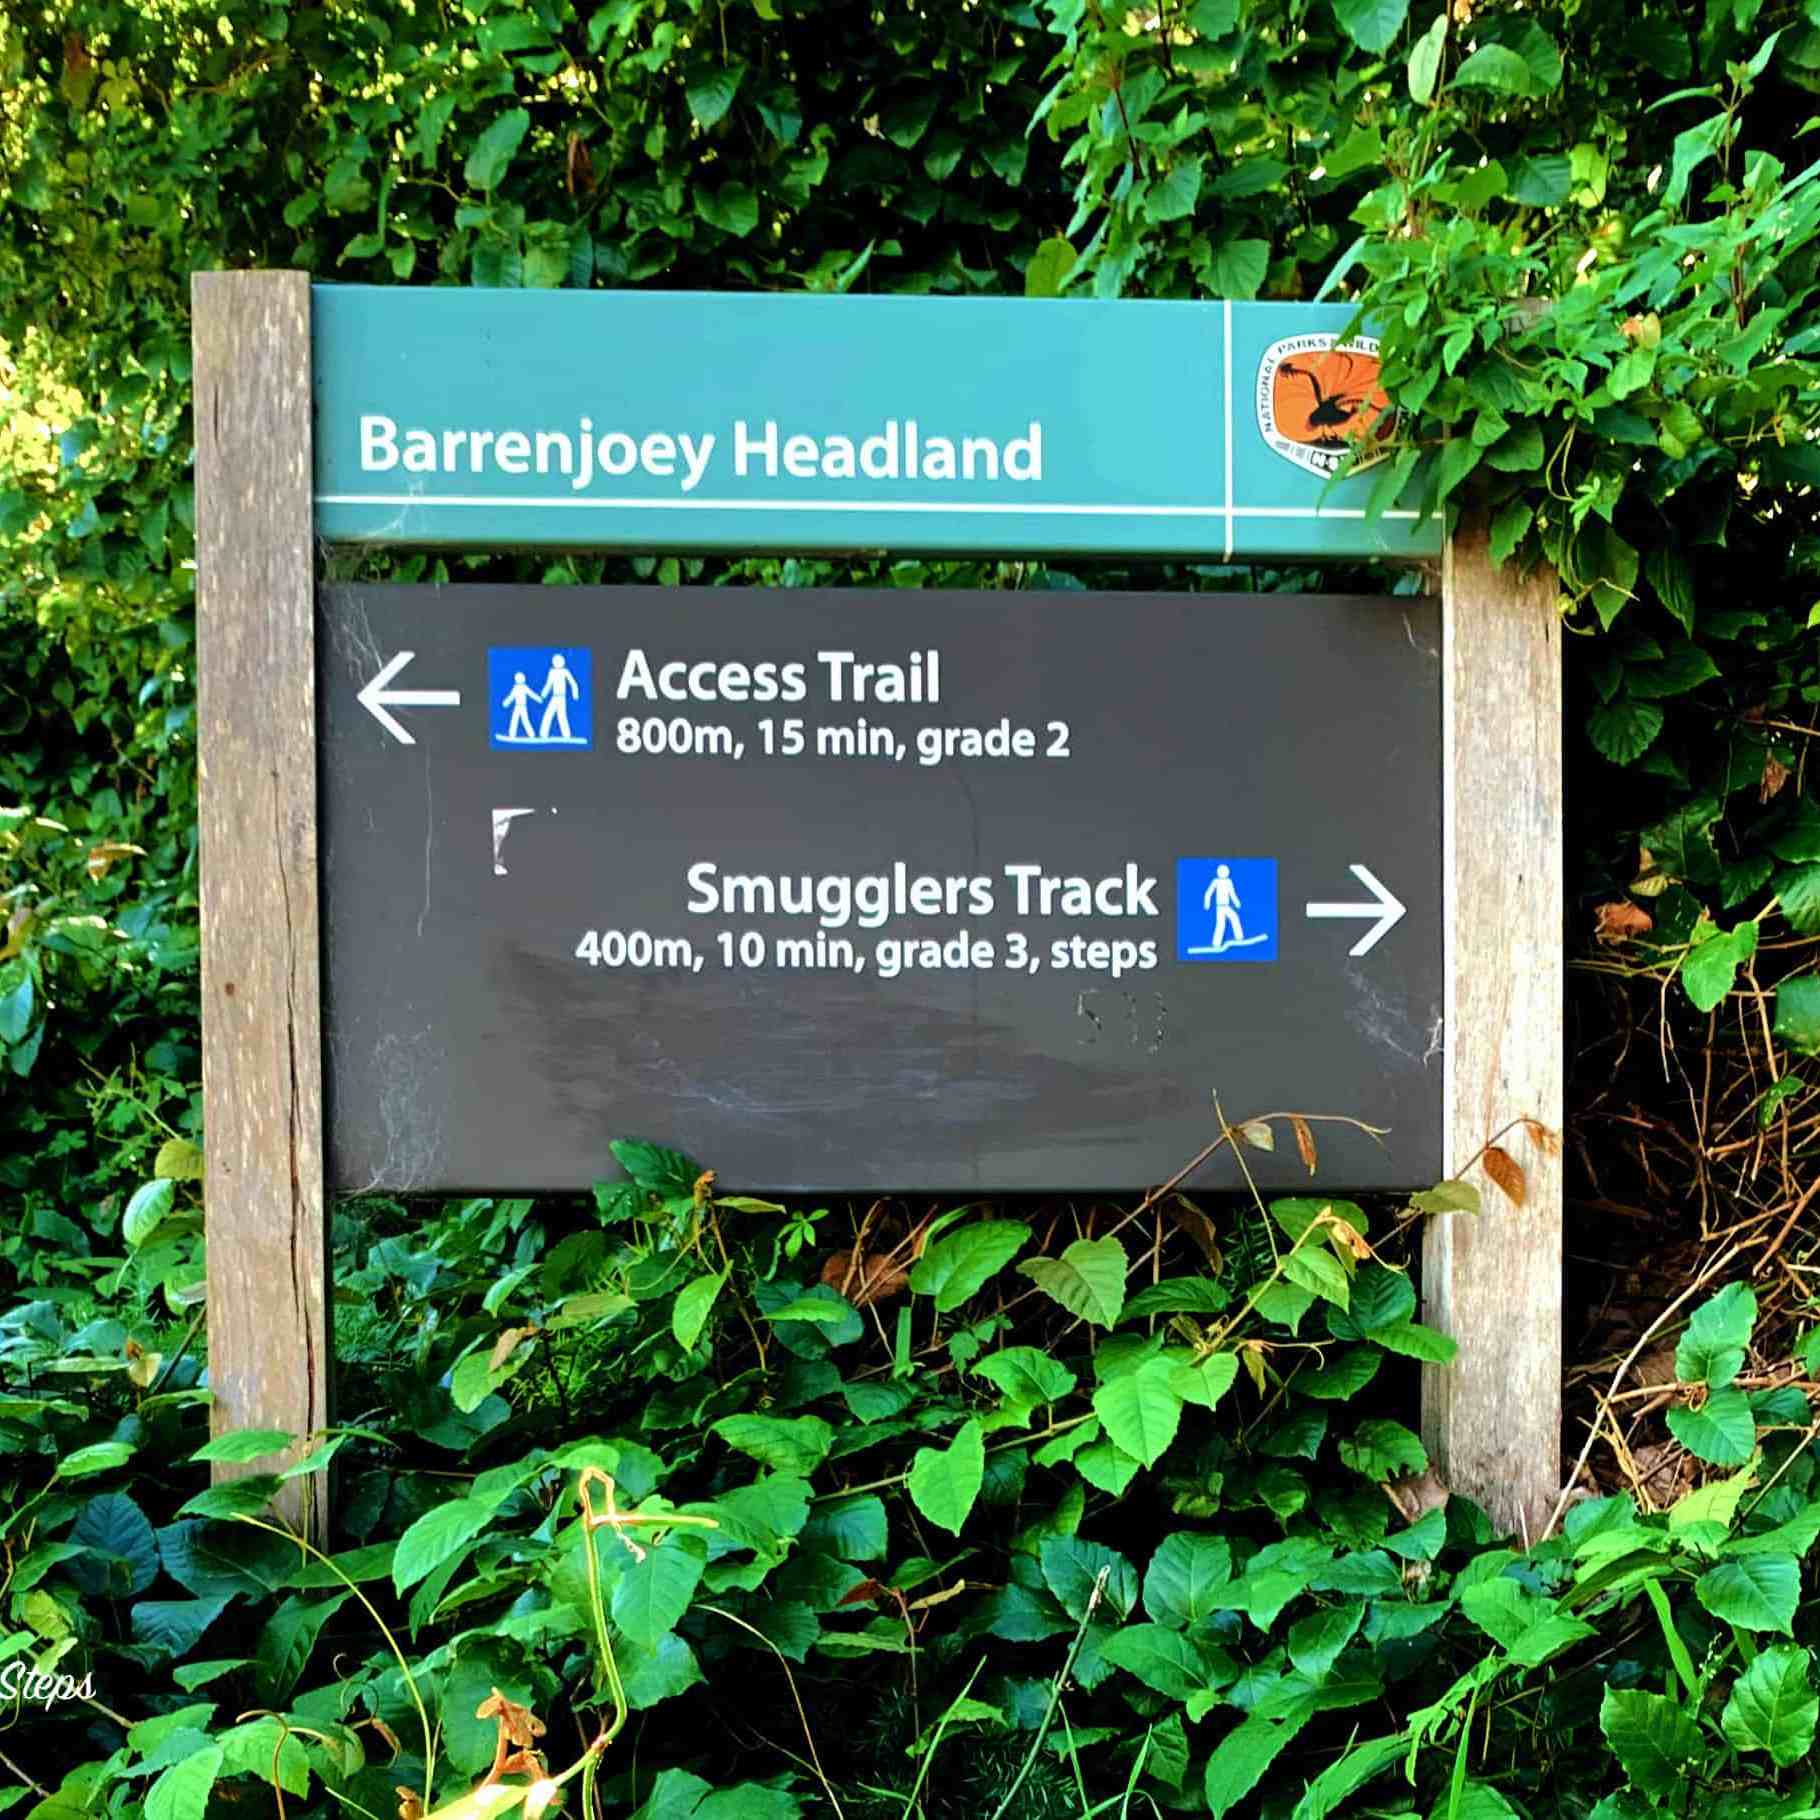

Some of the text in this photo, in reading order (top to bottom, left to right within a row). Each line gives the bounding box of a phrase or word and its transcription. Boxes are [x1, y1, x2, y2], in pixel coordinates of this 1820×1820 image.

[1260, 358, 1275, 432] NATIONAL
[1278, 338, 1327, 354] PARKS
[360, 415, 1042, 491] Barrenjoey Headland
[616, 649, 939, 703] Access Trail
[616, 717, 1070, 766] 800m, 15 min, grade 2
[687, 861, 1159, 928] Smugglers Track
[575, 928, 1158, 978] 400m, 10 min, grade 3, steps
